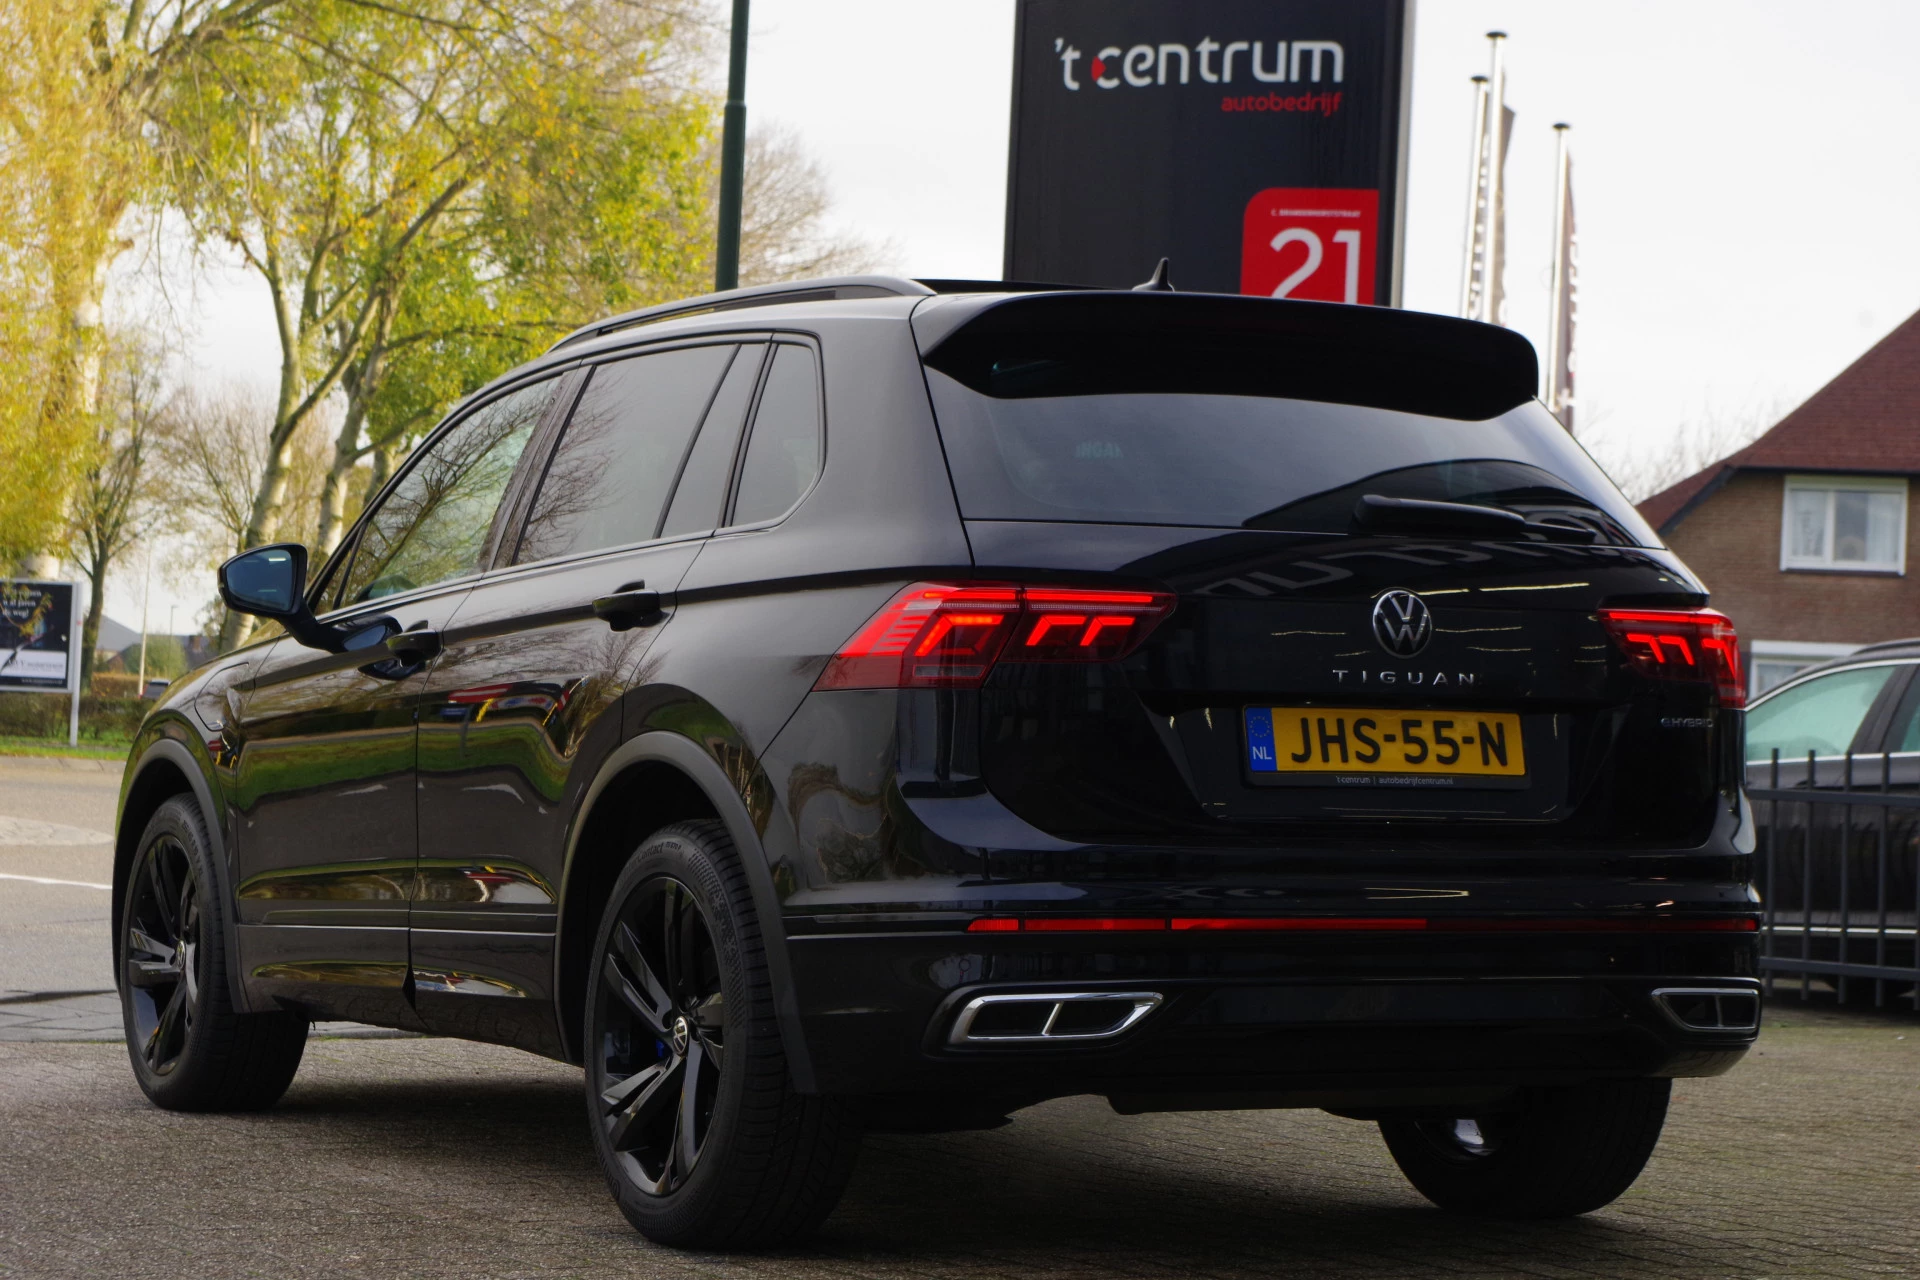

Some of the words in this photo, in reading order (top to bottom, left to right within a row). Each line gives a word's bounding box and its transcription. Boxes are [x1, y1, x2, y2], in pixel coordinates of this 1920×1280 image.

[1091, 36, 1345, 90] centrum
[1221, 91, 1344, 117] autobedrijf
[1269, 227, 1361, 304] 21
[1332, 668, 1476, 686] TIGUAN
[1251, 745, 1273, 761] NL
[1290, 716, 1509, 767] JHS-55-N
[1378, 775, 1454, 787] autobedrijfcentrum.nl
